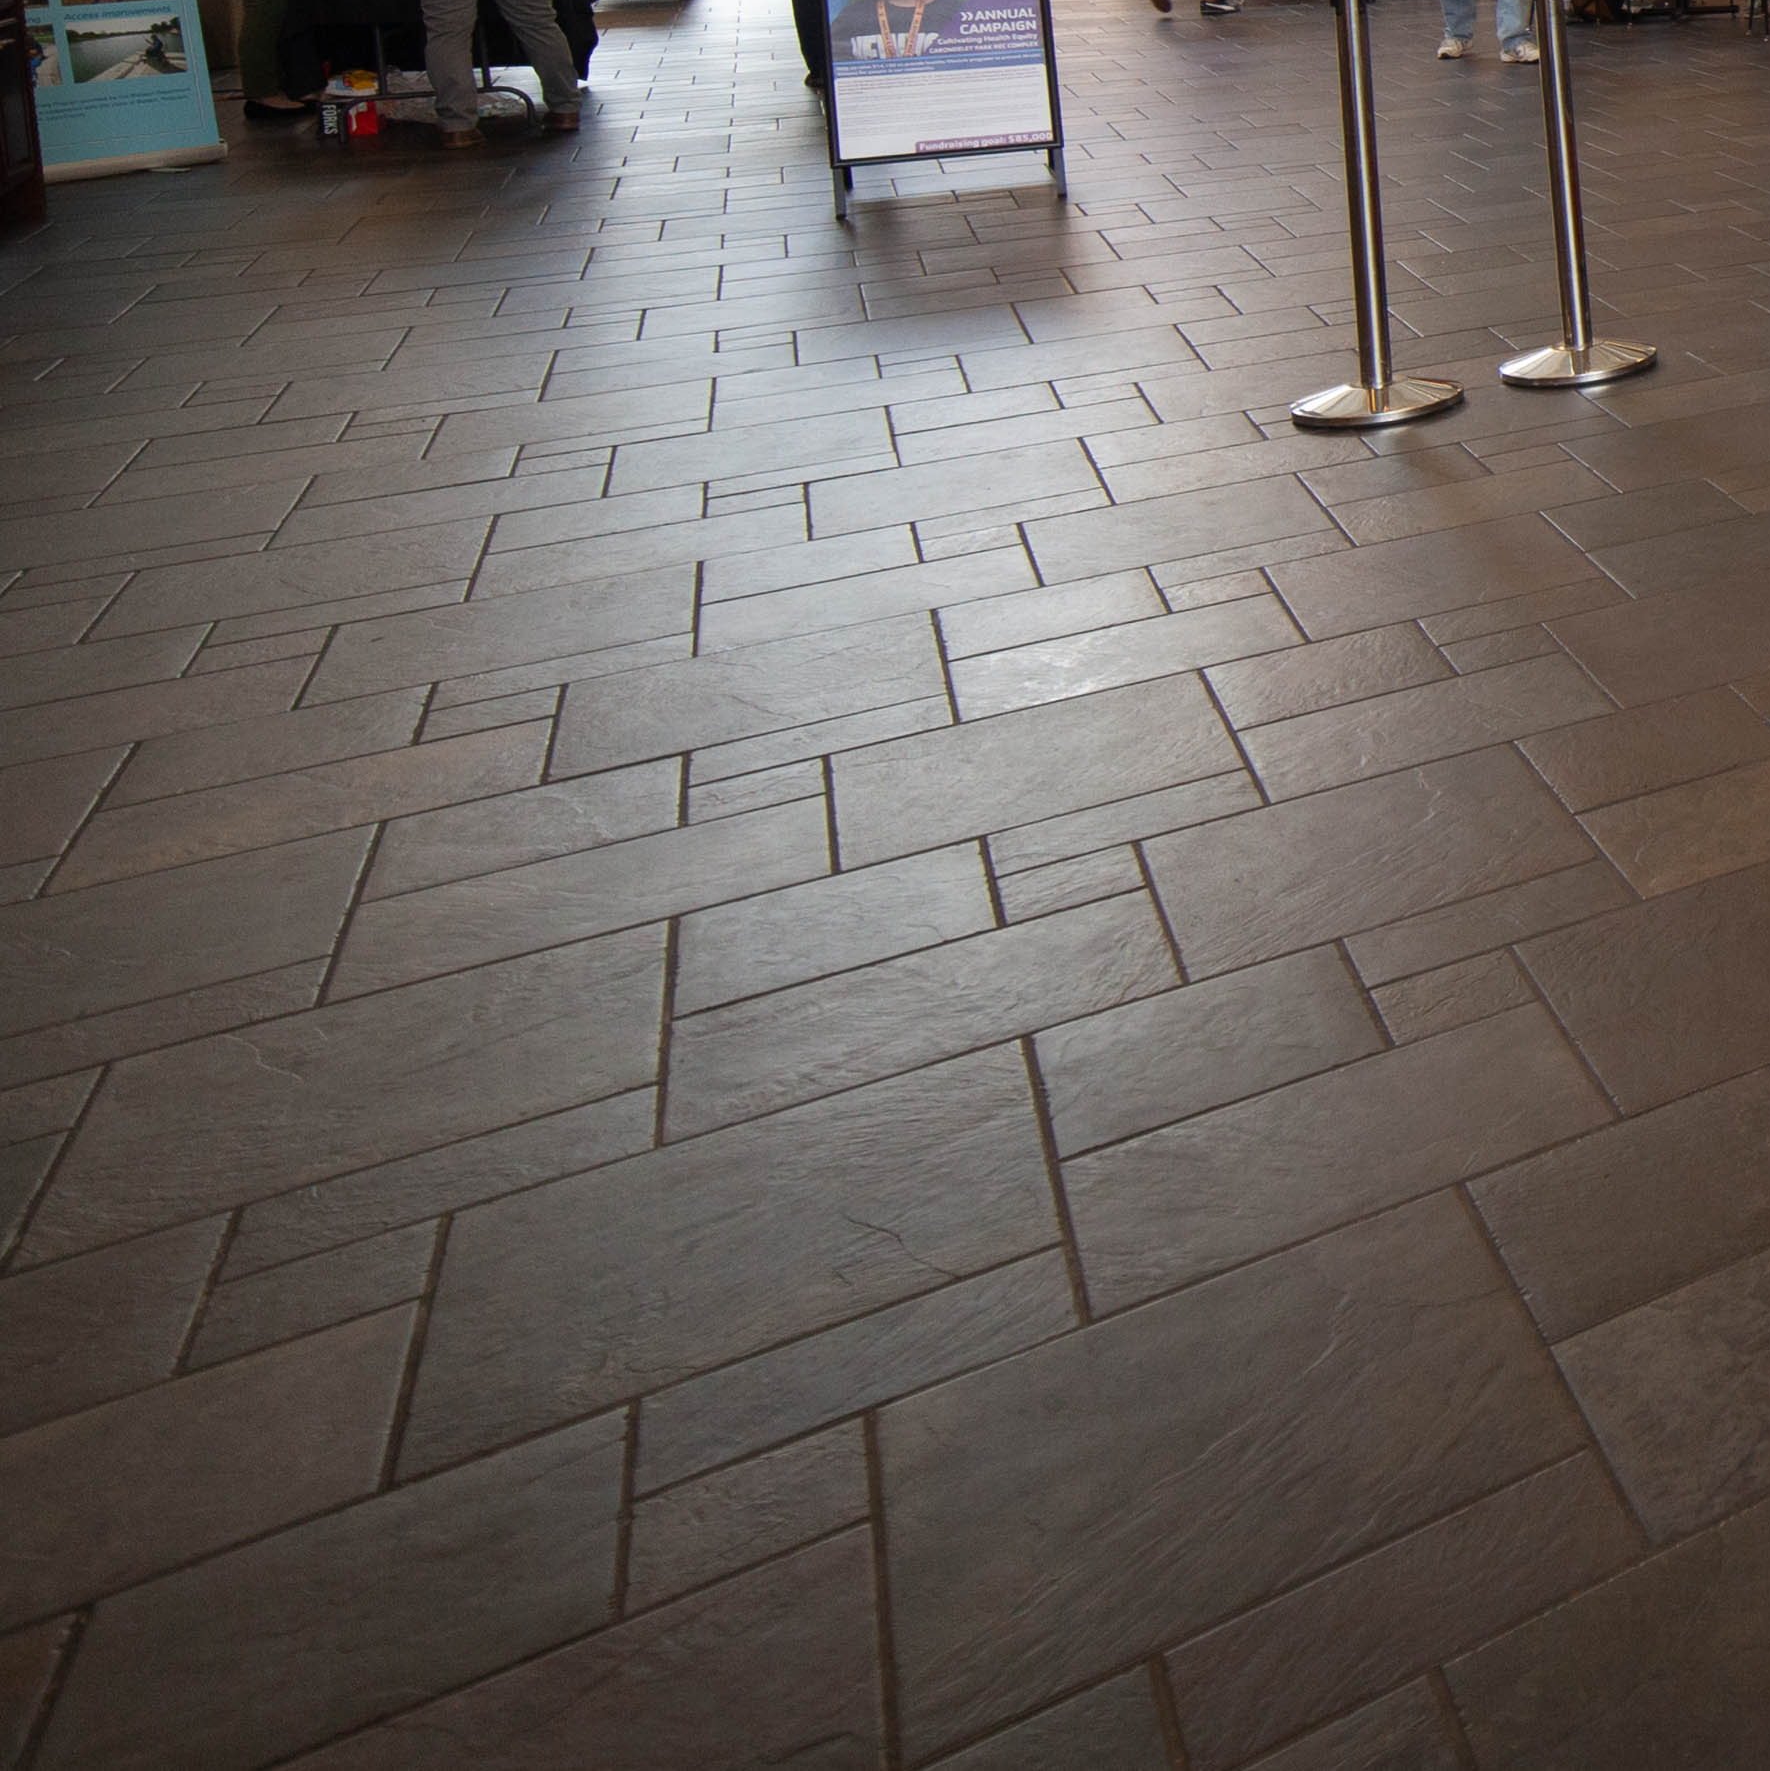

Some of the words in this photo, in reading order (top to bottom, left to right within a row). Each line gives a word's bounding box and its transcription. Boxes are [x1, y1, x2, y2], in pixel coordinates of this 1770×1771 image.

[64, 12, 99, 21] Access
[975, 8, 1037, 20] ANNUAL
[960, 20, 1037, 34] CAMPAIGN
[937, 35, 983, 45] Cultivating
[984, 34, 1011, 42] Health
[1012, 33, 1038, 41] Equity
[322, 104, 339, 135] FORKS
[919, 138, 979, 150] Fundraising
[981, 137, 1007, 147] goal:
